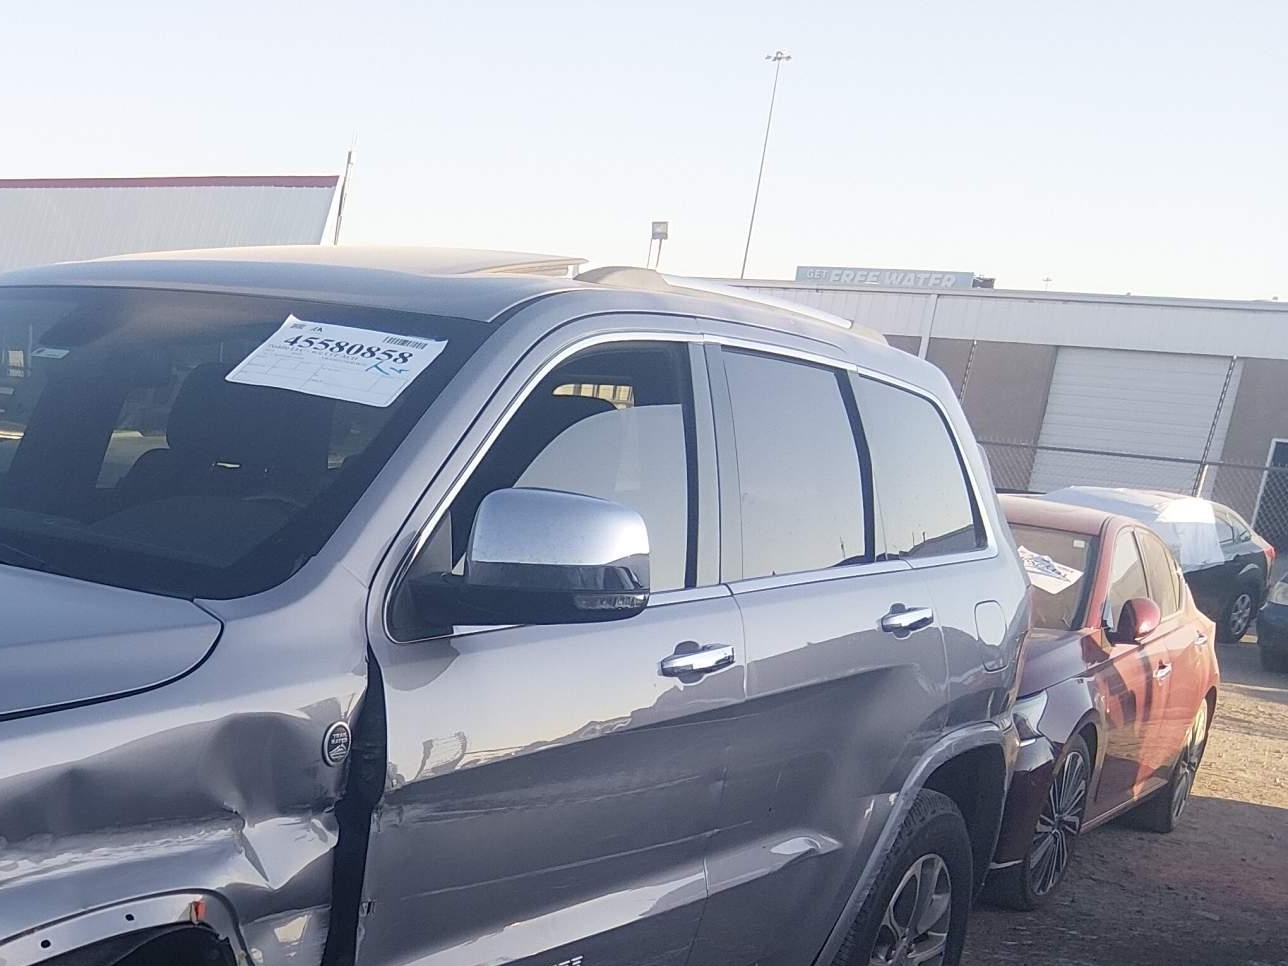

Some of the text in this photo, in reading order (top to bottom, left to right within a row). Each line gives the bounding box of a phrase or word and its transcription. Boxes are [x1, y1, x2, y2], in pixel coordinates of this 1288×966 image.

[830, 269, 881, 284] FREE
[885, 272, 956, 288] WATER
[284, 335, 414, 365] 45580858
